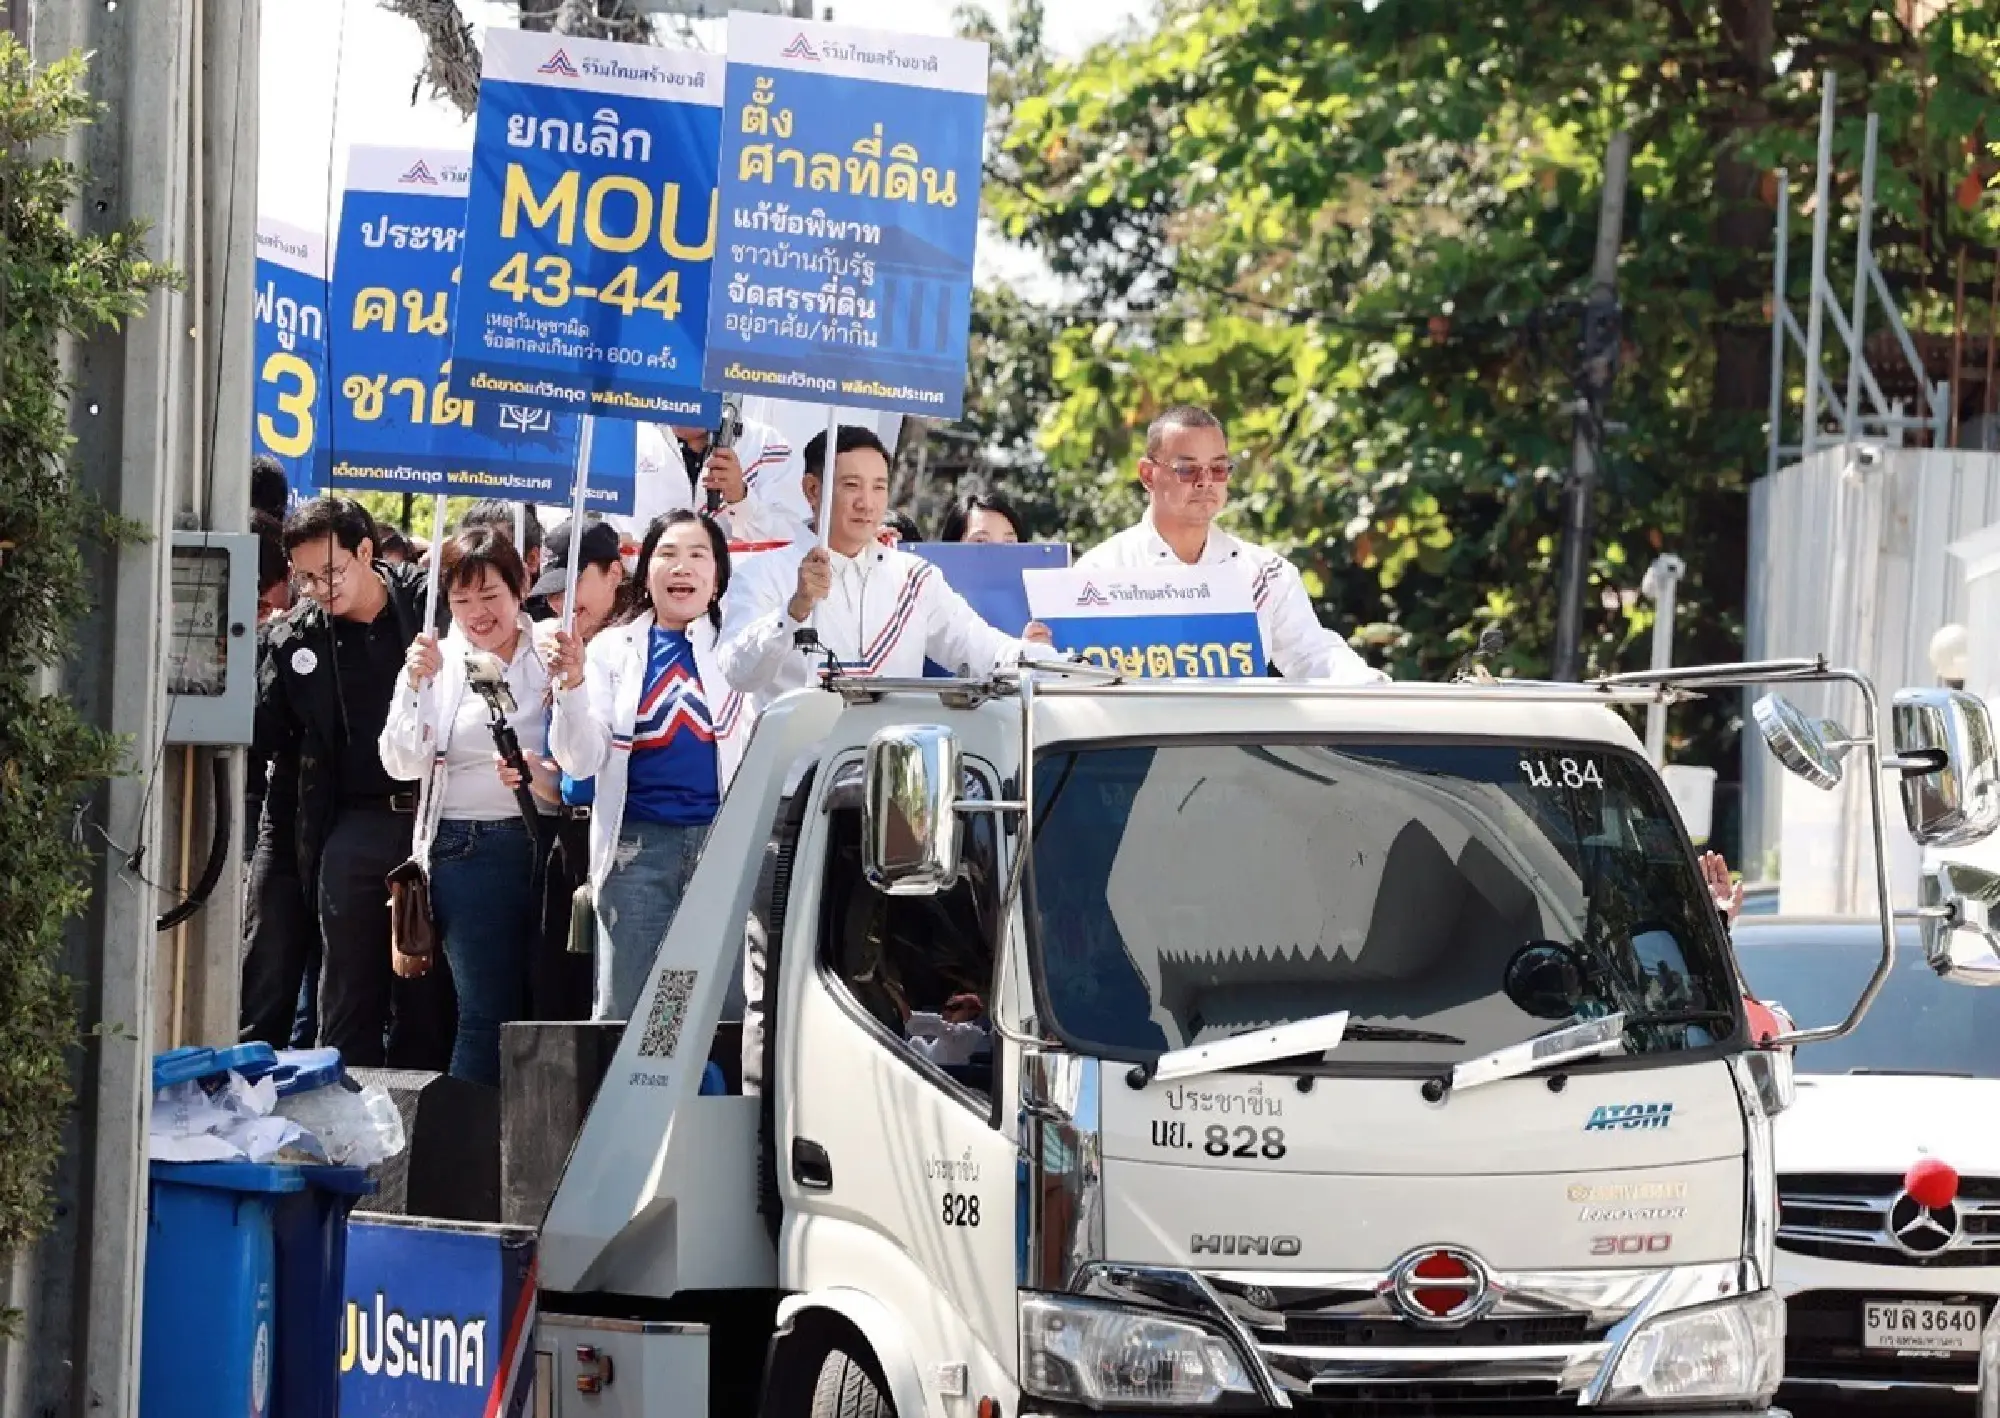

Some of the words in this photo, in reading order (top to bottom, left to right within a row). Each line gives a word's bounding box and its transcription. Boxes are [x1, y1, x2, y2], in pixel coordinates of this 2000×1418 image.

[741, 76, 793, 138] ตั้ง
[507, 108, 652, 164] ยกเลิก
[738, 122, 957, 207] ศาลที่ดิน
[500, 162, 719, 261] MOU
[734, 200, 880, 244] แก้ข้อพิพาท
[731, 242, 876, 286] ชาวบ้านกับรัฐ
[489, 252, 682, 320] 43-44
[728, 272, 876, 319] จัดสรรที่ดิน
[486, 311, 589, 339] เหตุกัมพูชาผิด
[725, 309, 877, 347] อยู่อาศัย/ทำกิน
[647, 345, 677, 369] ครั้ง
[257, 352, 316, 457] 3
[1519, 757, 1604, 789] น.84
[1166, 1080, 1283, 1117] ประชาชื่น
[1584, 1102, 1673, 1131] ATOM
[1204, 1123, 1286, 1160] 828
[943, 1192, 980, 1227] 828
[1190, 1233, 1302, 1257] HINO
[1589, 1232, 1673, 1256] 300
[1921, 1309, 1977, 1332] 3640
